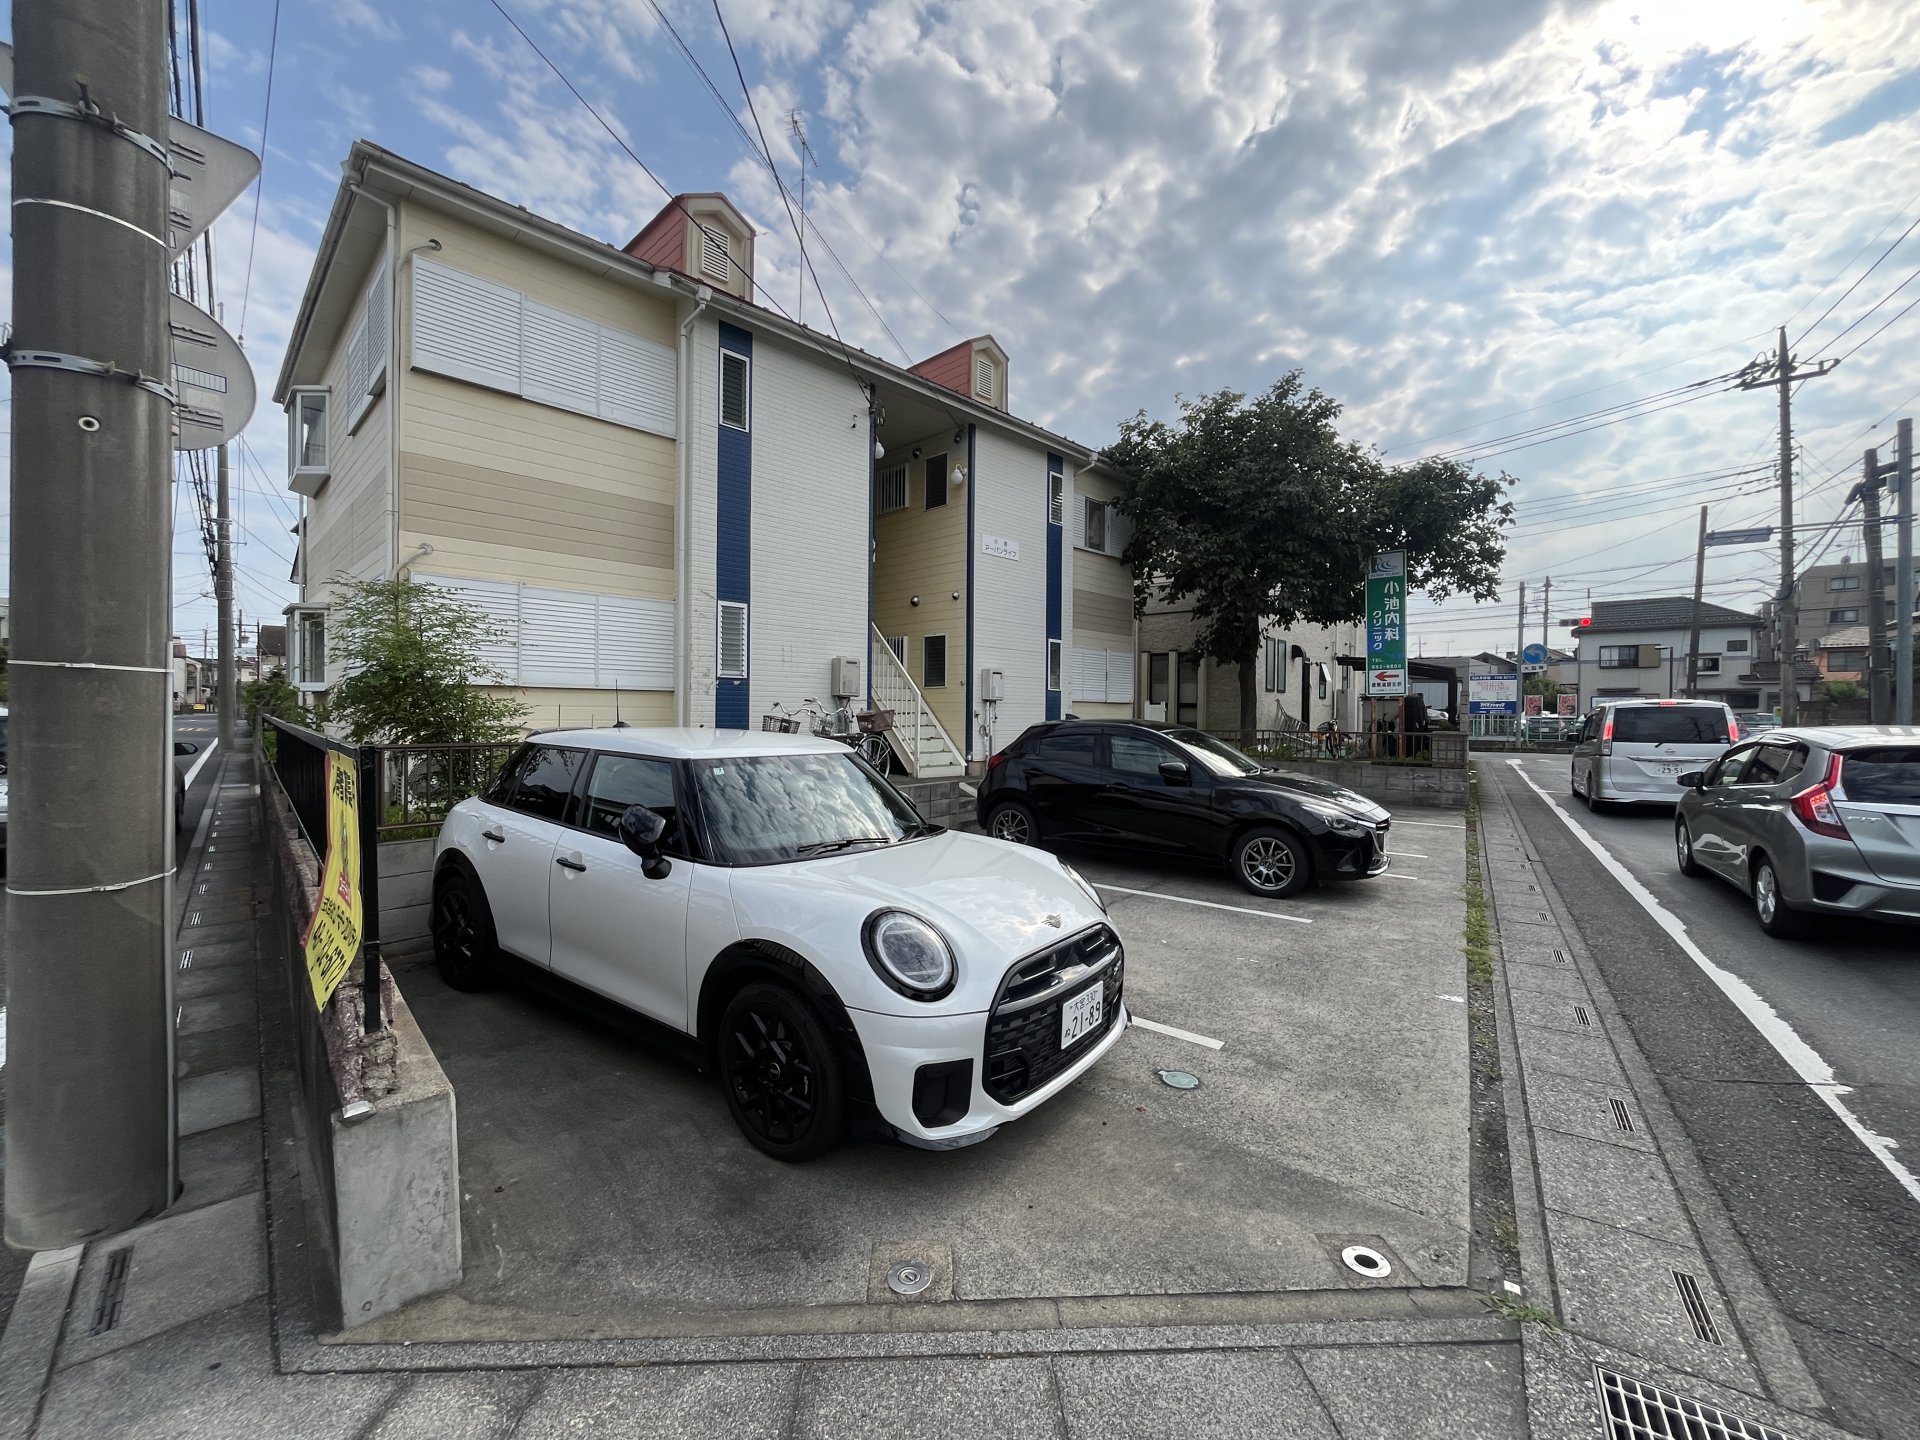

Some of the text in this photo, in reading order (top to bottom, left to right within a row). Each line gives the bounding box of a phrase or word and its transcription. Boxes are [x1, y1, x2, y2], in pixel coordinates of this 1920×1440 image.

[1373, 610, 1382, 650] クリニック
[1384, 581, 1400, 641] 小池内科
[1072, 1001, 1100, 1039] 21-89
